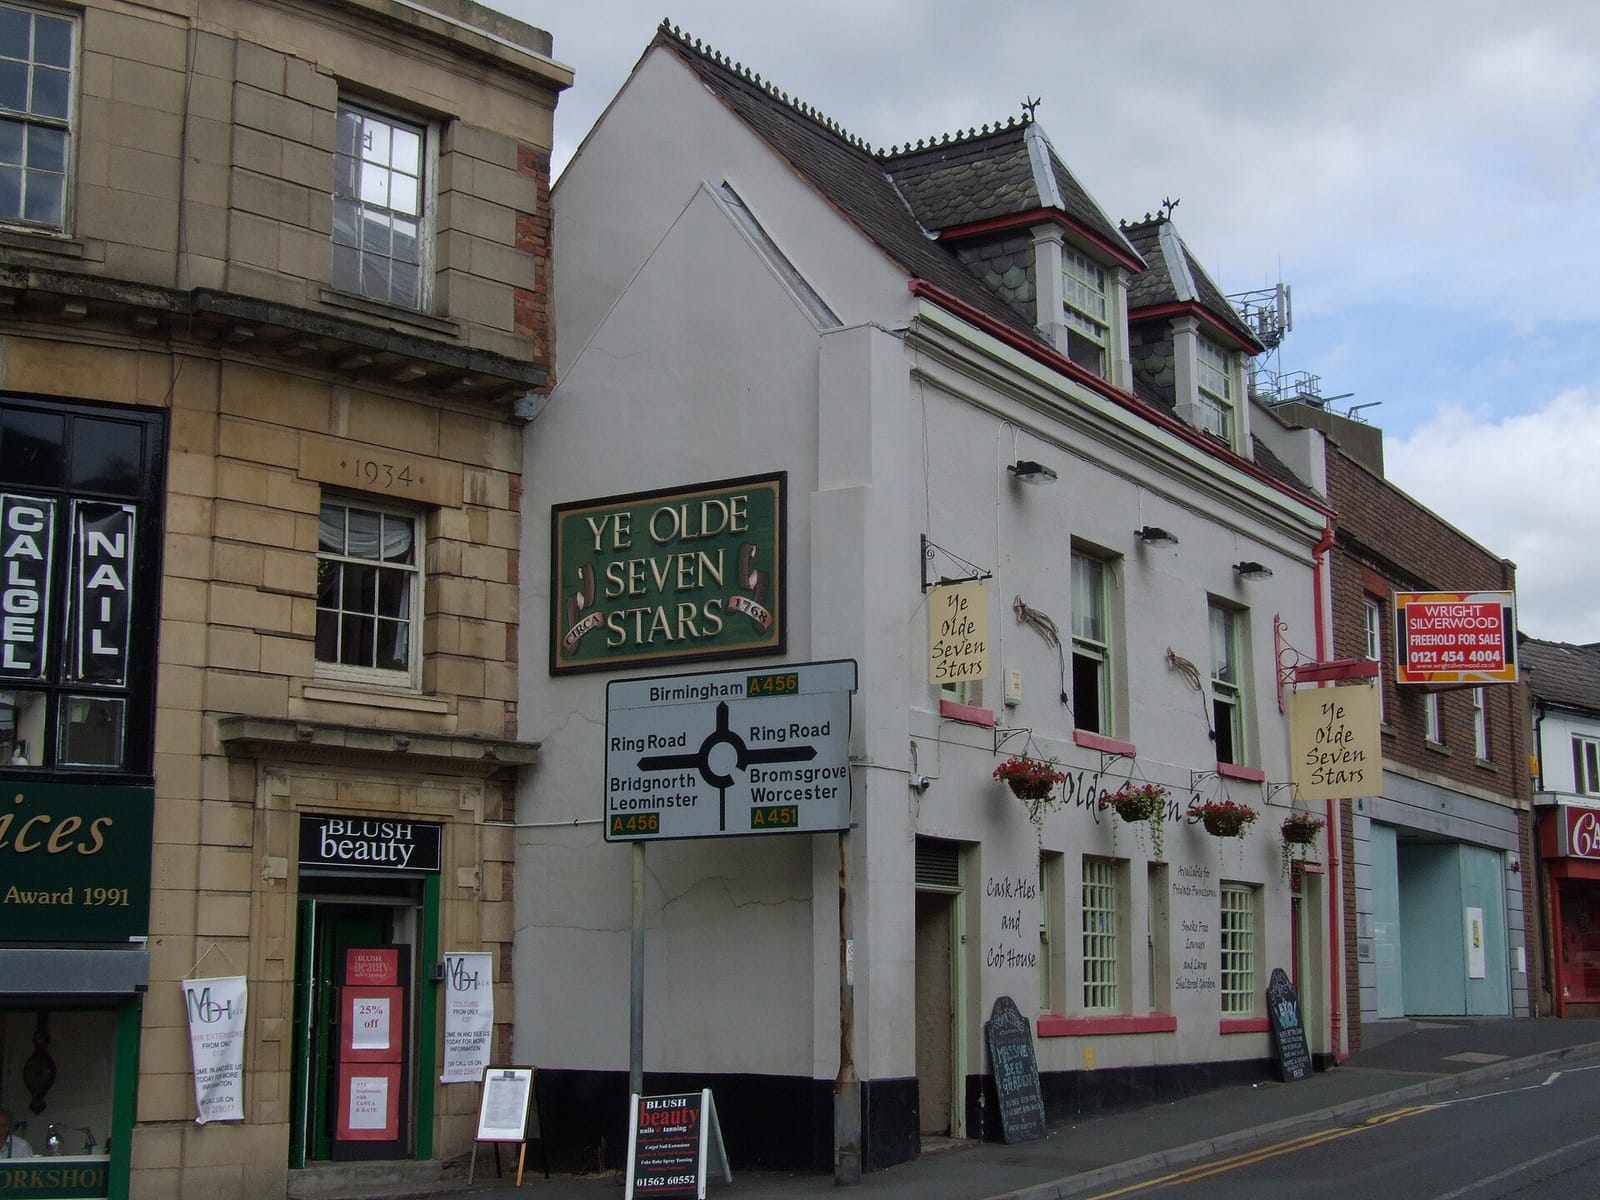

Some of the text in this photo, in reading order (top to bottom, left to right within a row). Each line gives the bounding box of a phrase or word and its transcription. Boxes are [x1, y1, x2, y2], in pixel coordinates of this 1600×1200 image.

[354, 459, 413, 488] 1934
[585, 496, 749, 550] YE OLDE
[605, 549, 726, 597] SEVEN
[3, 506, 44, 669] CALGEL
[87, 531, 125, 655] NAIL
[735, 598, 767, 623] 1768
[946, 594, 969, 621] Ye
[1425, 605, 1483, 617] WRIGHT
[566, 615, 600, 645] CIRCA
[607, 599, 723, 647] STARS
[941, 616, 976, 641] Olde
[1410, 617, 1498, 629] SILVERWOOD
[932, 640, 986, 659] Seven
[1411, 633, 1500, 646] FREEHOLD FOR SALE
[1411, 650, 1501, 662] 0121 454 4004
[935, 659, 982, 678] Stars
[650, 674, 796, 701] Birmingham A456
[1321, 703, 1346, 728] Ye
[751, 721, 830, 742] Ring Road
[1315, 724, 1354, 749] Olde
[611, 732, 686, 752] Ring Road
[1306, 747, 1366, 766] Seven
[611, 774, 696, 792] Bridgnorth
[751, 766, 847, 783] Bromsgrove
[1311, 767, 1364, 785] Stars
[611, 794, 698, 811] Leominster
[751, 785, 838, 803] Worcester
[1063, 772, 1110, 825] Olde
[613, 814, 657, 831] A456
[753, 808, 797, 825] A451
[328, 820, 413, 840] BLUSH
[320, 825, 415, 869] beauty
[4, 885, 130, 906] Award 1991
[987, 876, 1036, 899] Cask Ales
[1001, 910, 1021, 938] and
[354, 953, 390, 978] beauty
[1007, 948, 1037, 968] House
[359, 1005, 383, 1015] 25%
[364, 1018, 380, 1028] off
[647, 1099, 686, 1109] BLUSH
[639, 1101, 699, 1128] beauty
[636, 1175, 695, 1187] 01562 60552
